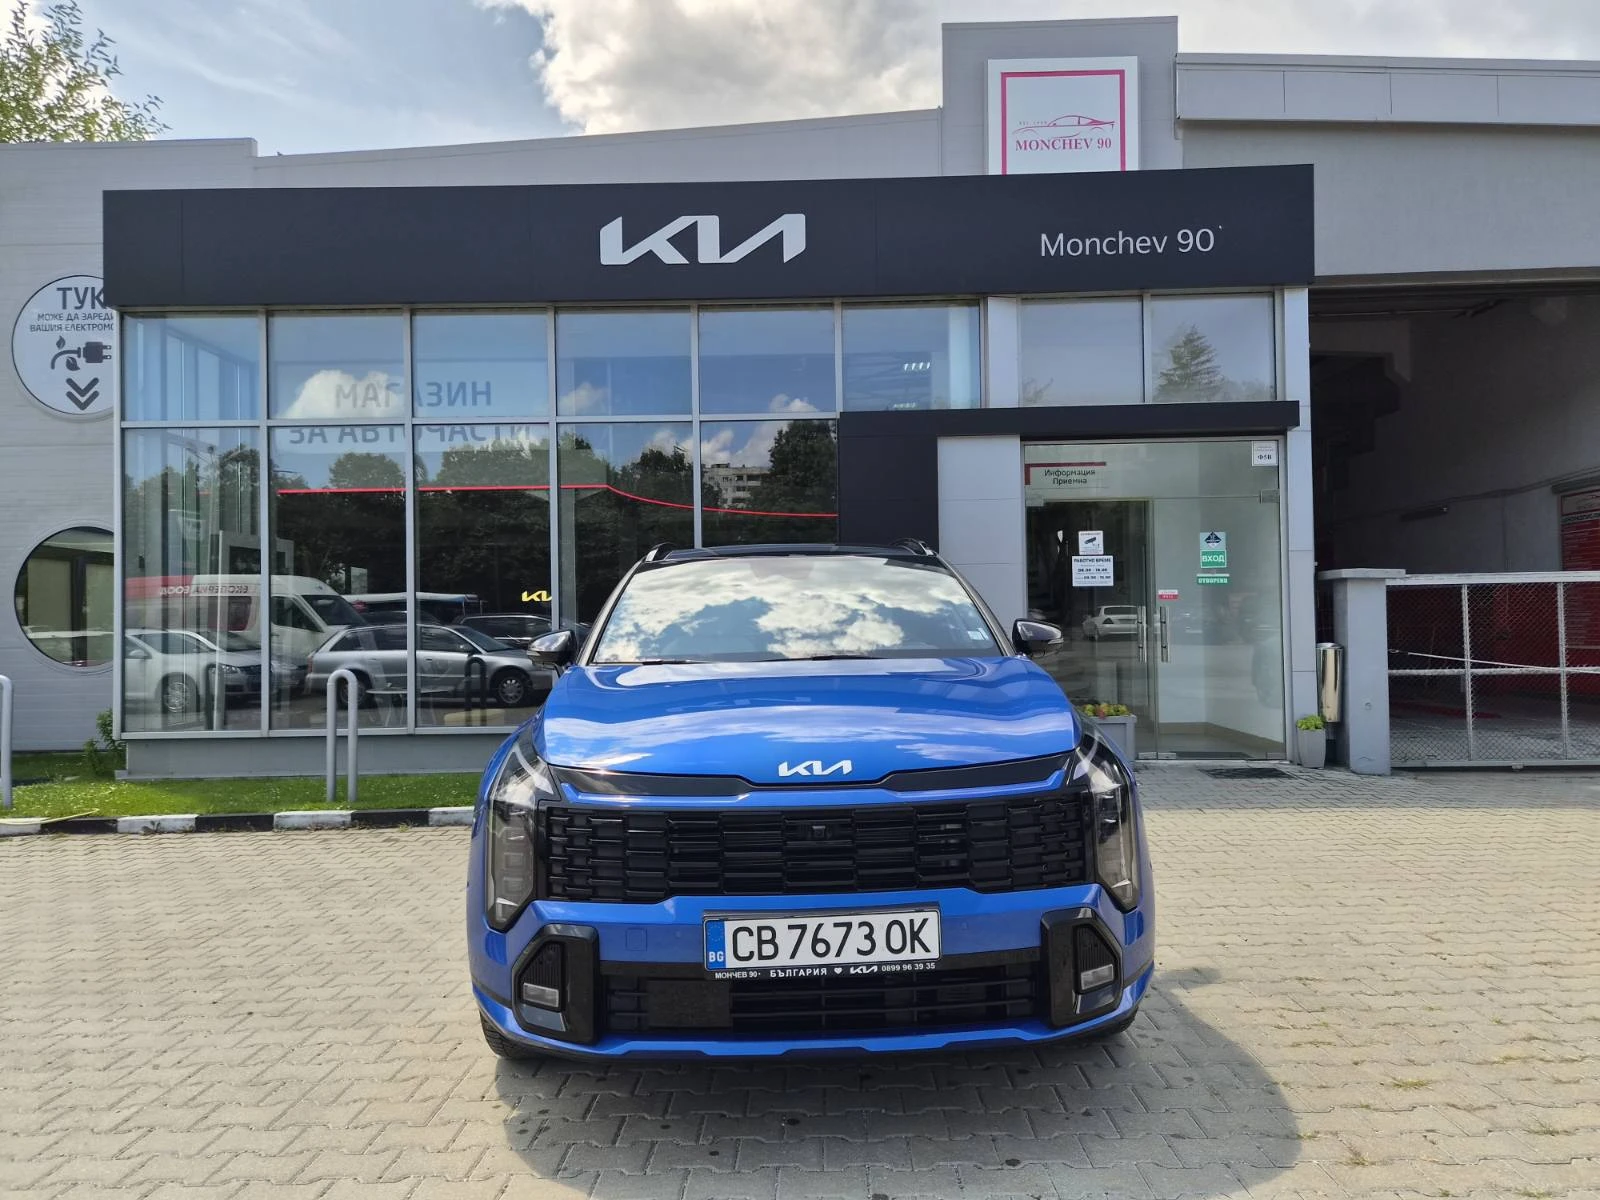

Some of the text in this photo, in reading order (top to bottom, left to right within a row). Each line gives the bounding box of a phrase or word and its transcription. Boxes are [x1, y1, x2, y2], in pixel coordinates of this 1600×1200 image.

[1015, 138, 1112, 151] MONCHEV 90
[600, 213, 806, 265] KIA
[1040, 230, 1168, 257] Monchev
[56, 287, 106, 310] ТУК
[37, 313, 63, 321] МОЖЕ
[66, 313, 79, 322] ДА
[30, 324, 62, 332] ВАШИЯ
[335, 381, 491, 409] МАГЗИН
[1044, 469, 1095, 477] Информация
[1052, 477, 1087, 485] Приемна
[1202, 554, 1225, 563] ВХОД
[521, 590, 553, 602] KI
[778, 760, 853, 777] KIA
[732, 917, 931, 962] CB 7673 OK
[708, 951, 724, 962] BG
[715, 971, 748, 979] МОНЧЕВ
[770, 968, 828, 978] БЪЛГАРИЯ
[850, 965, 878, 974] KIA
[881, 964, 900, 972] 0899
[902, 963, 912, 971] 96
[926, 962, 936, 970] 35
